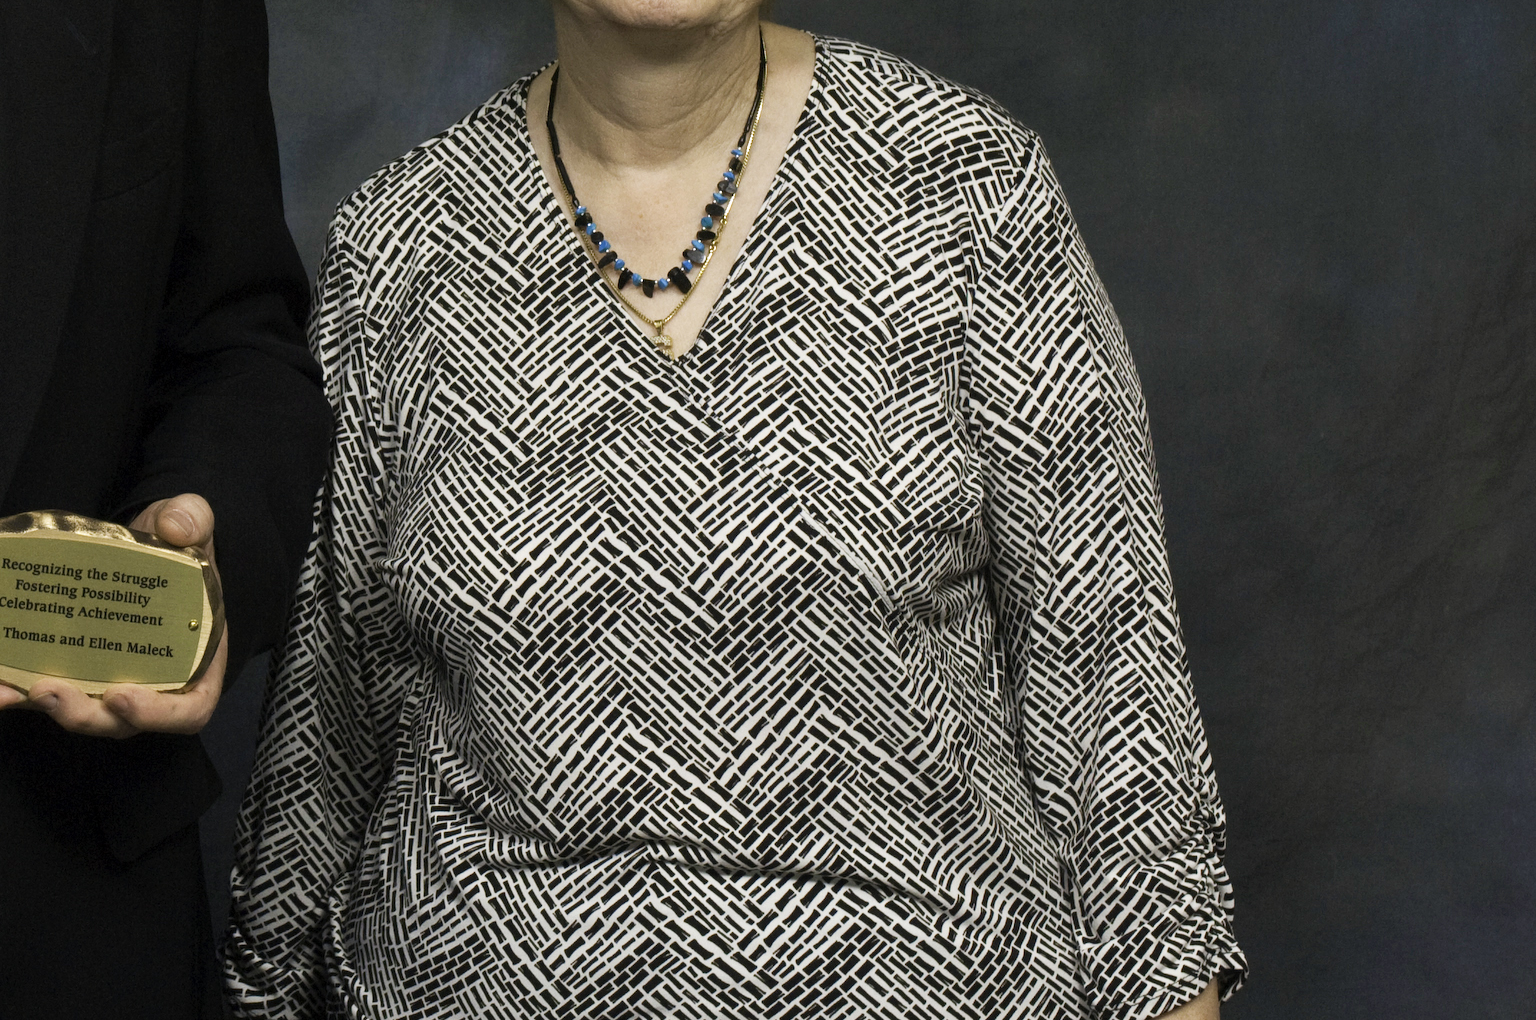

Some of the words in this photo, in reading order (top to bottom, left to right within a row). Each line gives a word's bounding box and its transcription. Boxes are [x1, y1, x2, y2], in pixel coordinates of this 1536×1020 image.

[1, 557, 83, 581] Recognizing
[87, 567, 109, 581] the
[111, 571, 168, 590] Struggle
[15, 578, 78, 600] Fostering
[80, 586, 151, 609] Possibility
[77, 606, 164, 627] Achievement
[3, 626, 56, 644] Thomas
[59, 635, 85, 648] and
[88, 637, 123, 652] Ellen
[126, 641, 174, 658] Maleck
